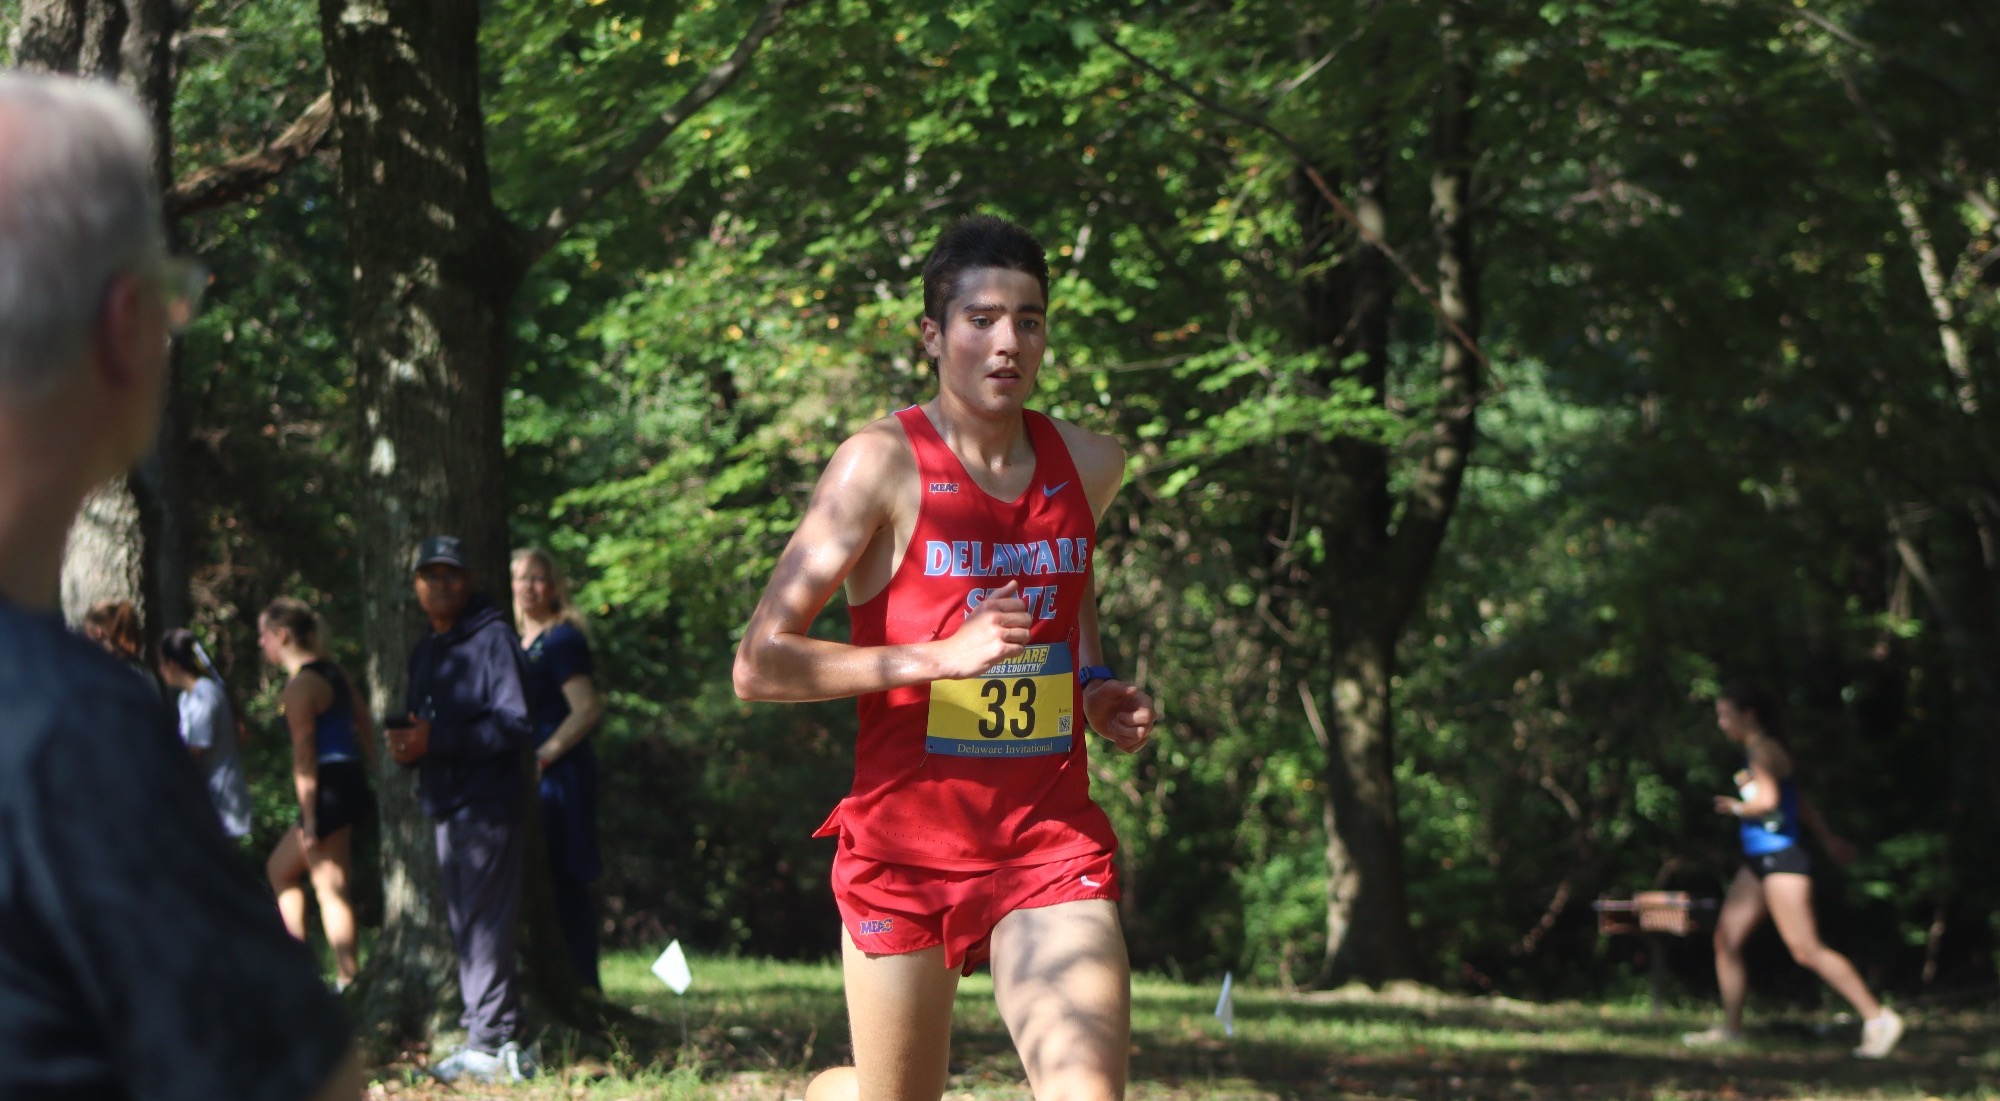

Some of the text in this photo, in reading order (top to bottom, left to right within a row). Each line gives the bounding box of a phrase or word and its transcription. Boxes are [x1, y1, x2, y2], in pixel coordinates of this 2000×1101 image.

[929, 483, 959, 494] MEAC
[924, 537, 1088, 577] DELAWARE
[964, 585, 1058, 620] STE
[1007, 663, 1041, 673] COUNTRY
[978, 678, 1037, 738] 33
[957, 742, 1053, 754] Delaware Invitational
